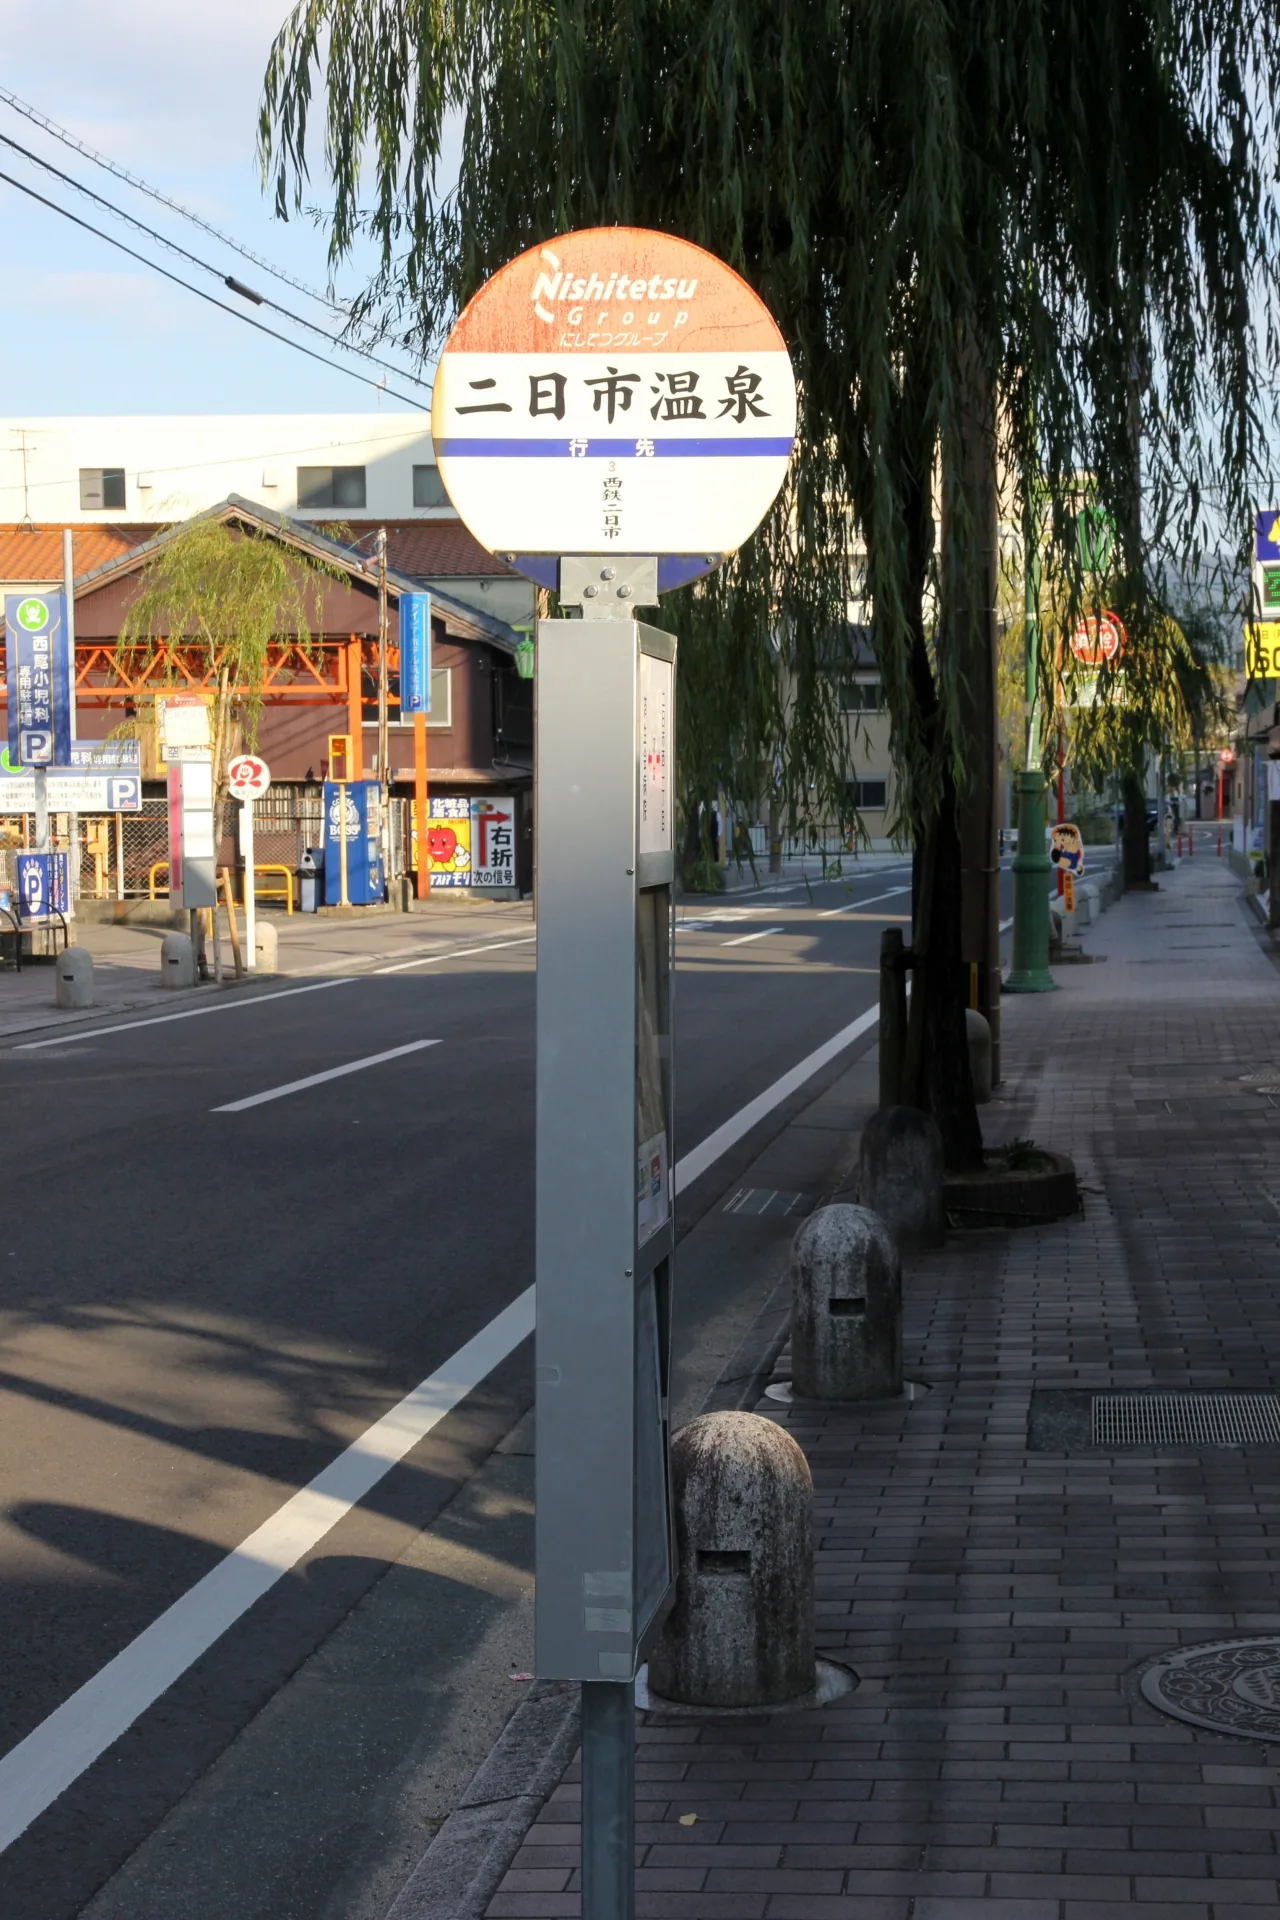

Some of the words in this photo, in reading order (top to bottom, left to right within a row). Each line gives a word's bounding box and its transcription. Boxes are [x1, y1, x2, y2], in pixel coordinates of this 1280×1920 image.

[531, 271, 698, 301] Nishitetsu
[567, 305, 689, 329] Group
[559, 331, 669, 348] にしてつグループ
[454, 365, 773, 425] 二日市温泉
[607, 461, 616, 473] 3
[601, 476, 623, 541] 西鉄二日市
[32, 635, 50, 724] 西尾小児科
[26, 734, 47, 760] P
[112, 779, 136, 808] P
[432, 798, 469, 809] 化粧品
[490, 826, 513, 867] 右折
[473, 870, 513, 884] 次の信号
